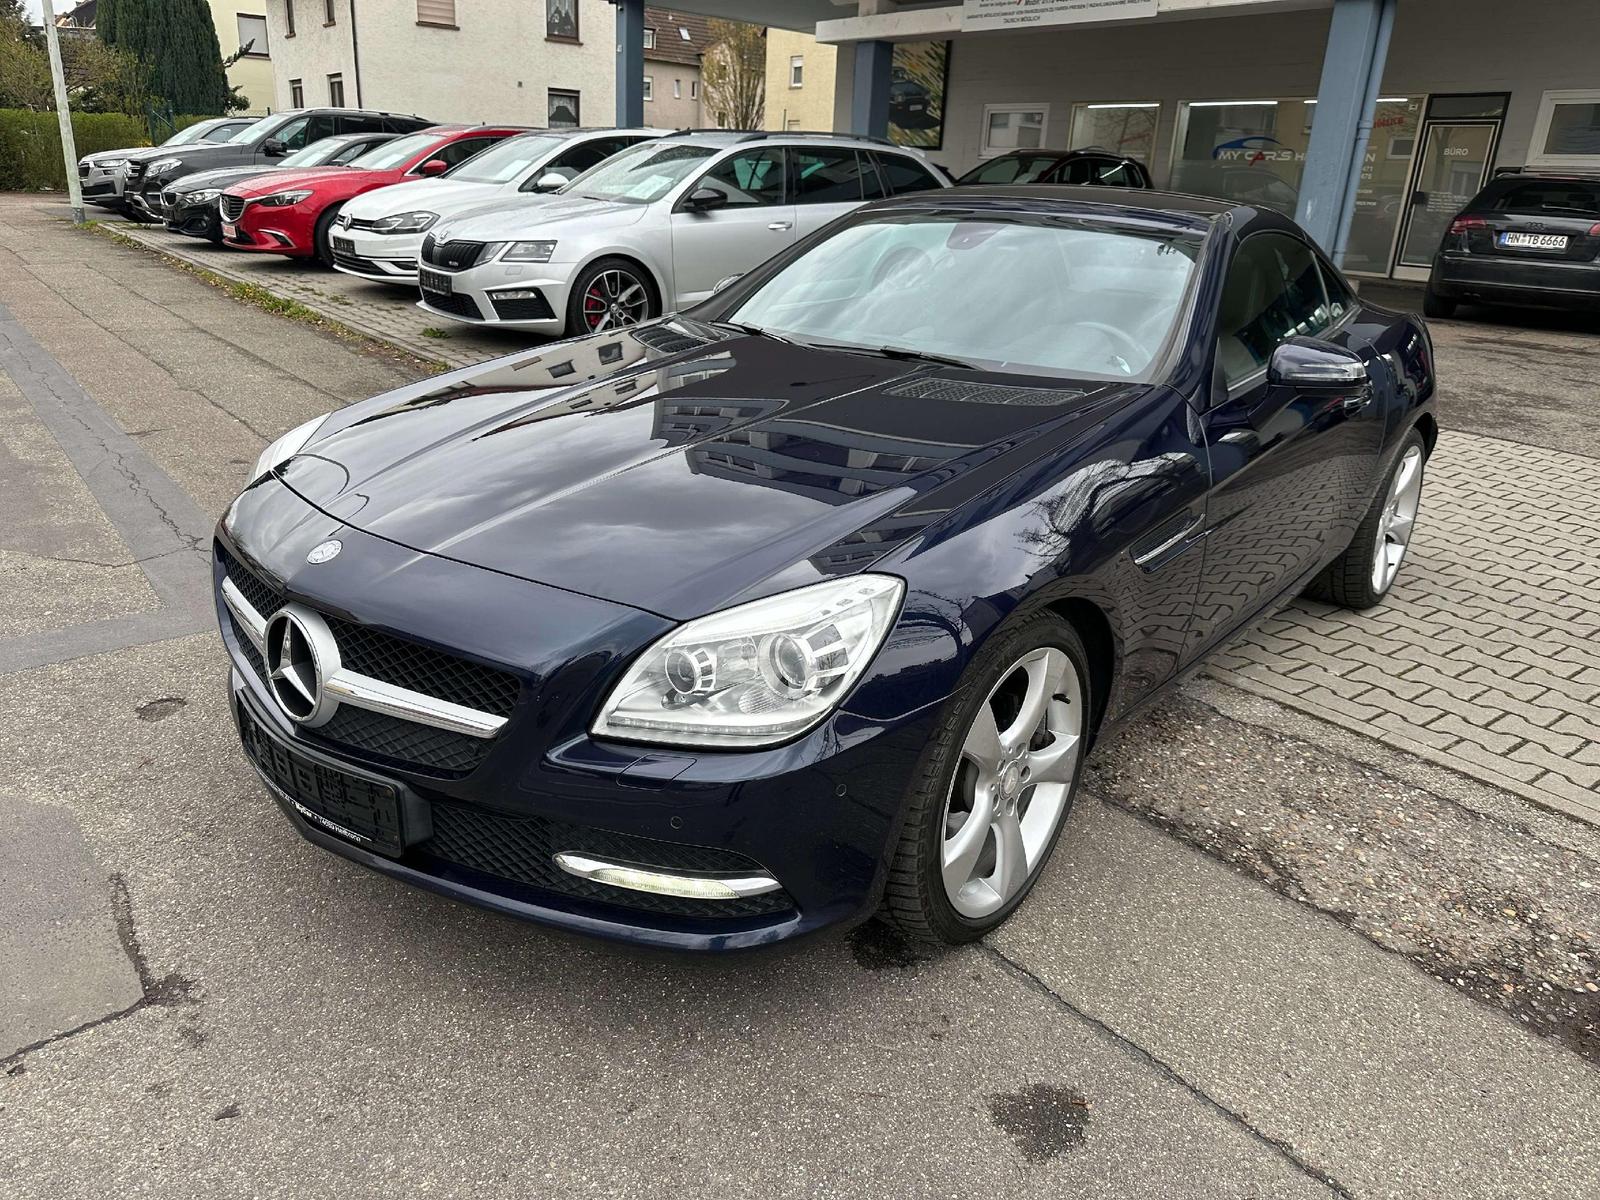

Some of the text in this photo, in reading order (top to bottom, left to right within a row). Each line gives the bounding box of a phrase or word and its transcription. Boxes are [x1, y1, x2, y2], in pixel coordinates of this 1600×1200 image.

[1218, 151, 1240, 160] MY
[1443, 146, 1469, 156] BÜRO
[1507, 233, 1565, 247] HN TB 6666
